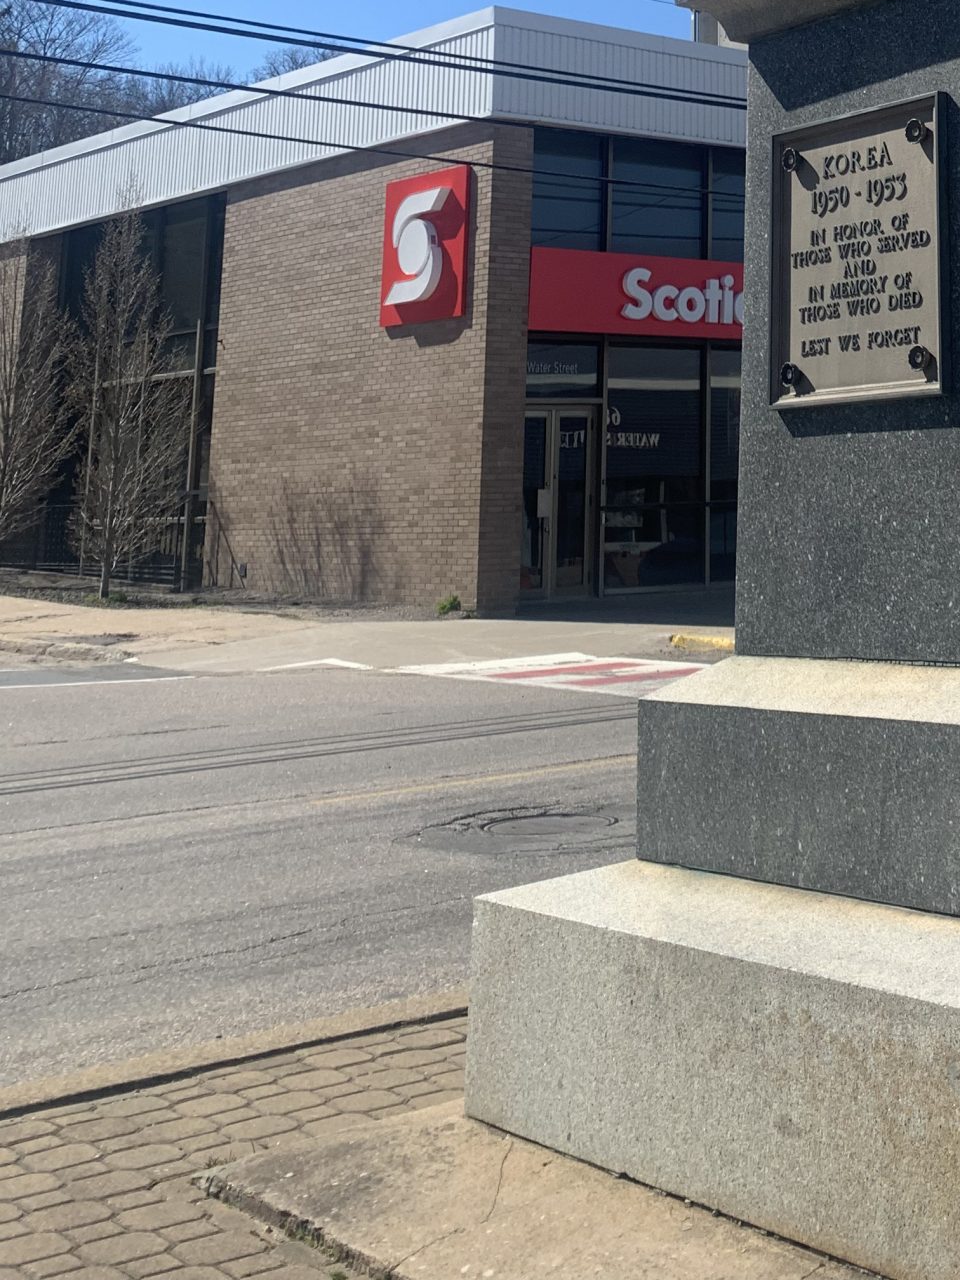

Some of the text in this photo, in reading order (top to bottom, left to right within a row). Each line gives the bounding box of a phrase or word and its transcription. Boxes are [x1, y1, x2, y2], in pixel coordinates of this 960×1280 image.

[822, 141, 893, 180] KOREA
[811, 185, 850, 218] 1950
[866, 172, 908, 207] 1953
[810, 212, 910, 247] IN HONOR OF
[791, 230, 932, 269] THOSE WHO SERVED
[843, 259, 877, 280] AND
[808, 271, 912, 304] IN MEMORY OF
[799, 290, 924, 325] THOSE WHO DIED
[801, 325, 921, 358] LEST WE FORGET
[527, 361, 578, 374] Water Street
